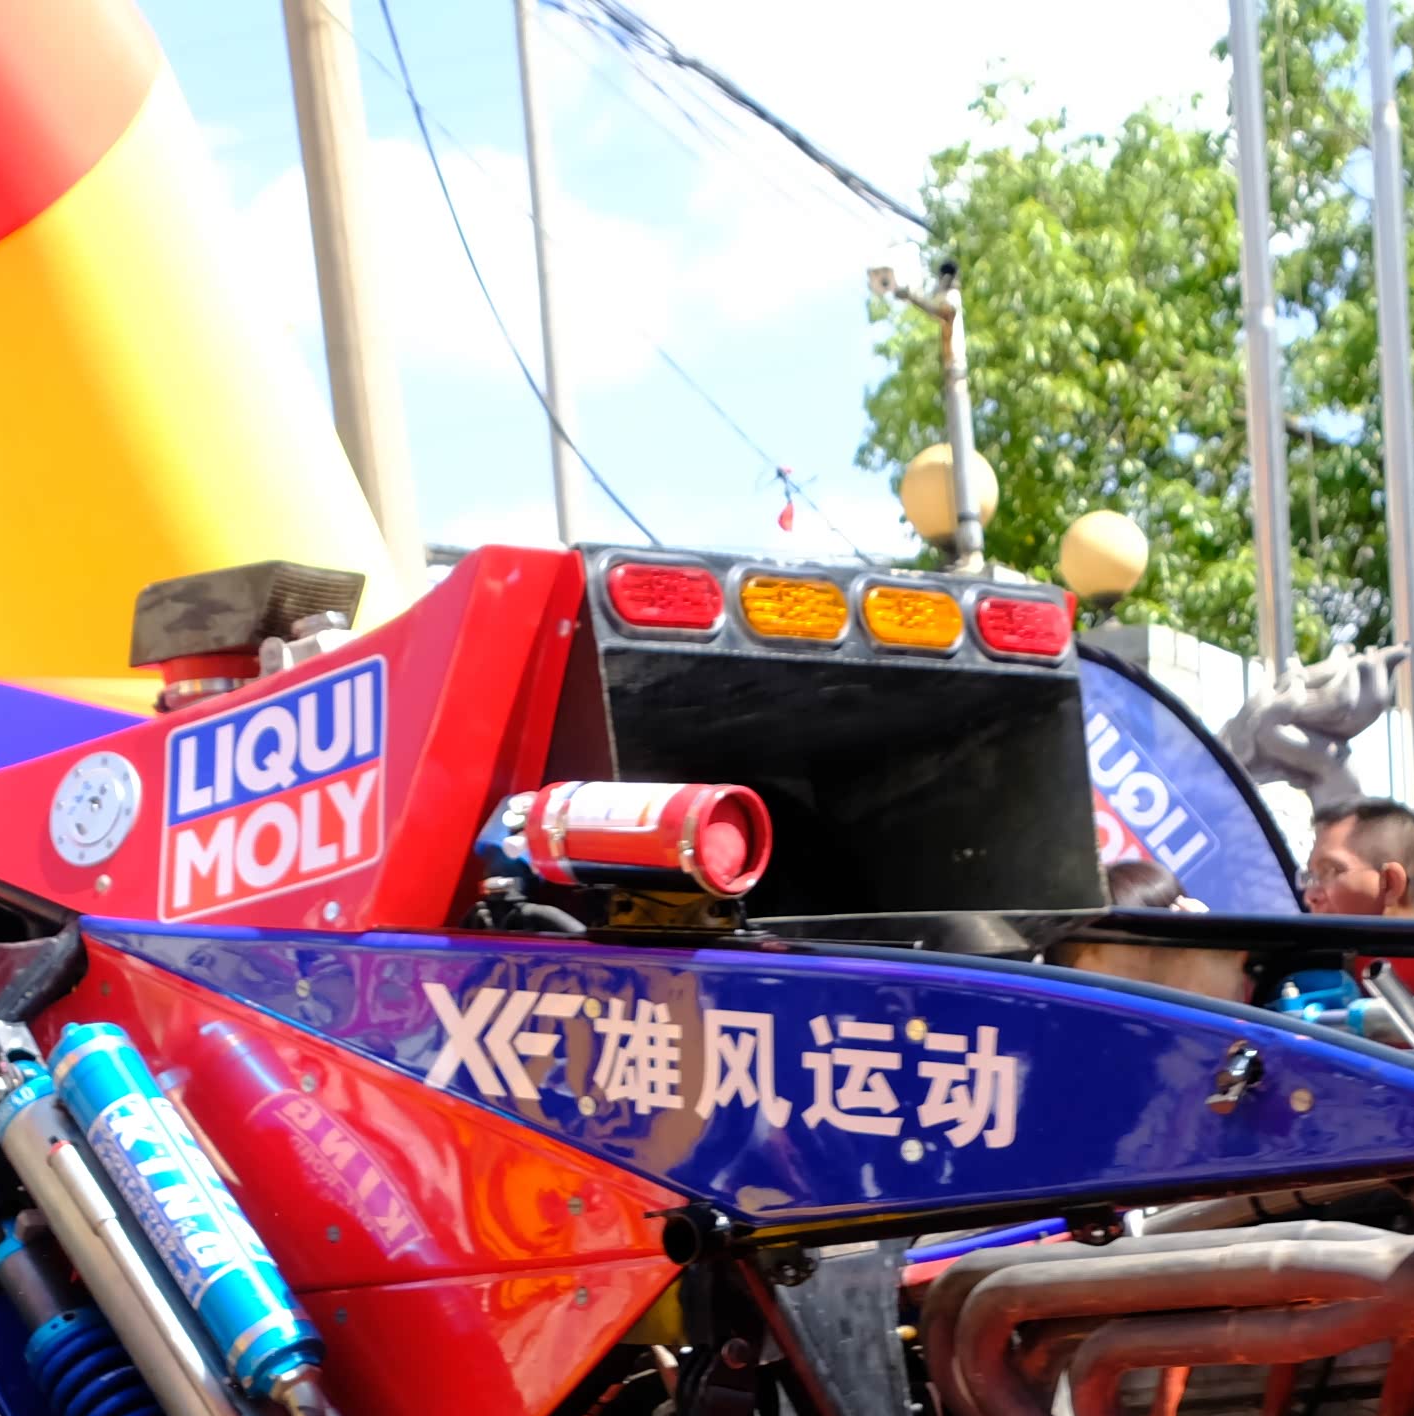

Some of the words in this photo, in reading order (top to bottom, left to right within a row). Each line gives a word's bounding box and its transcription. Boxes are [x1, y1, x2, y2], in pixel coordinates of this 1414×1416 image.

[176, 670, 375, 816] LIQUI
[1085, 711, 1209, 873] LIQUI
[171, 767, 379, 909] MOLY
[593, 998, 1019, 1150] 雄风运动
[108, 1108, 239, 1271] KING
